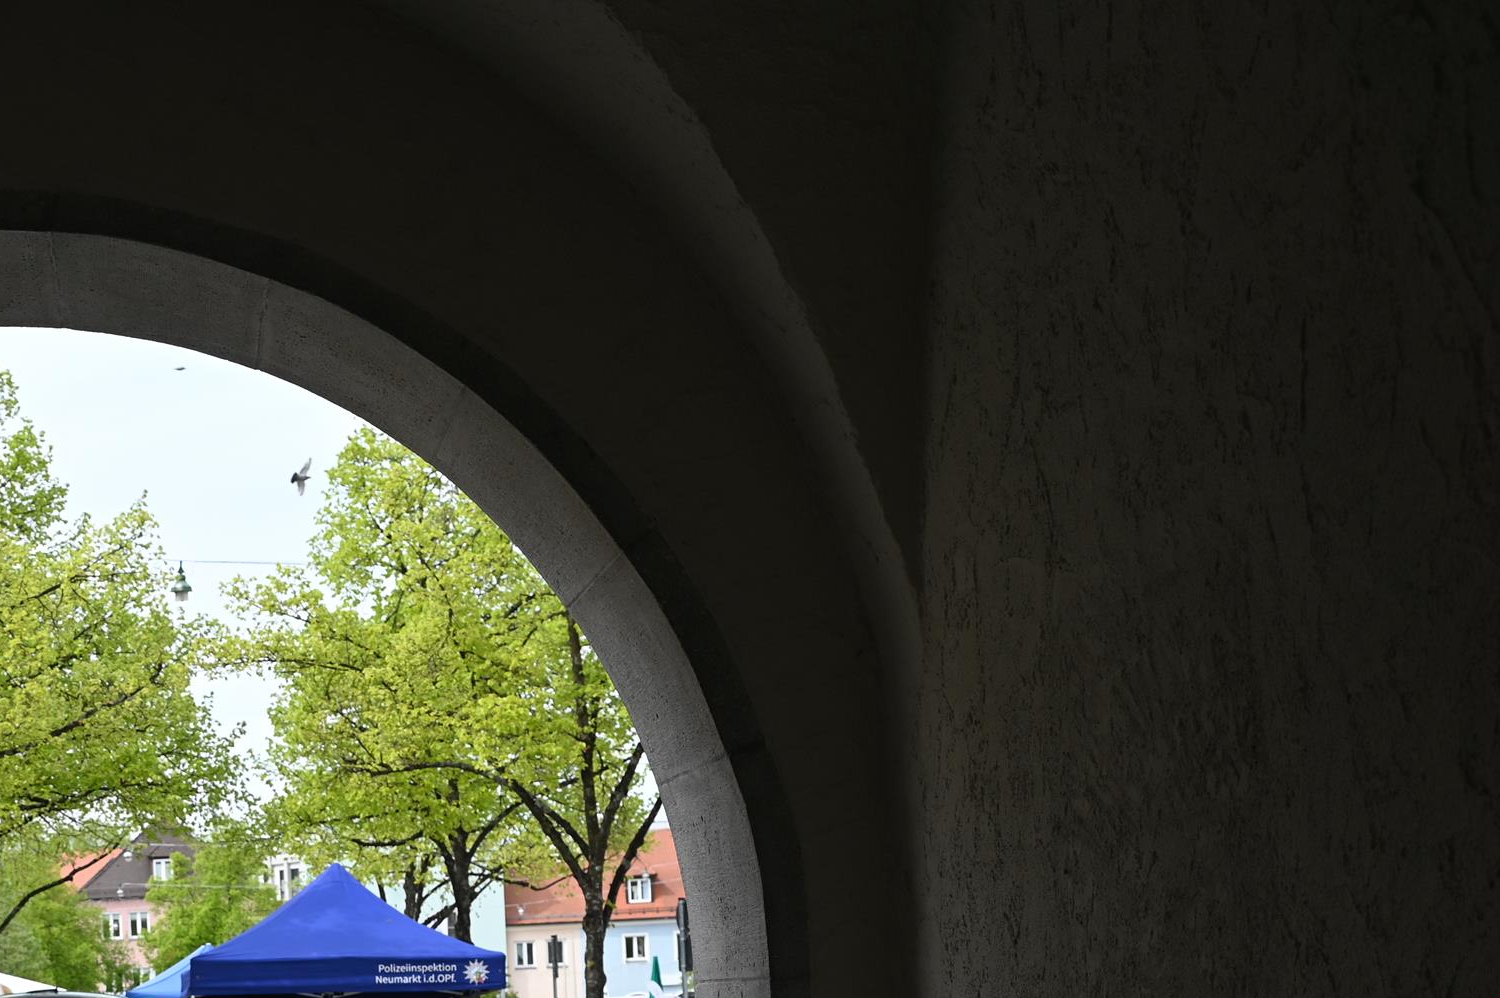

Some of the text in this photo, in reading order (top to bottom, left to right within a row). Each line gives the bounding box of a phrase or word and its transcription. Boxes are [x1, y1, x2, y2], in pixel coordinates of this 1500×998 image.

[378, 963, 457, 974] Polizeiinspektion
[375, 974, 457, 984] Neumarkt i.d.OPf.
